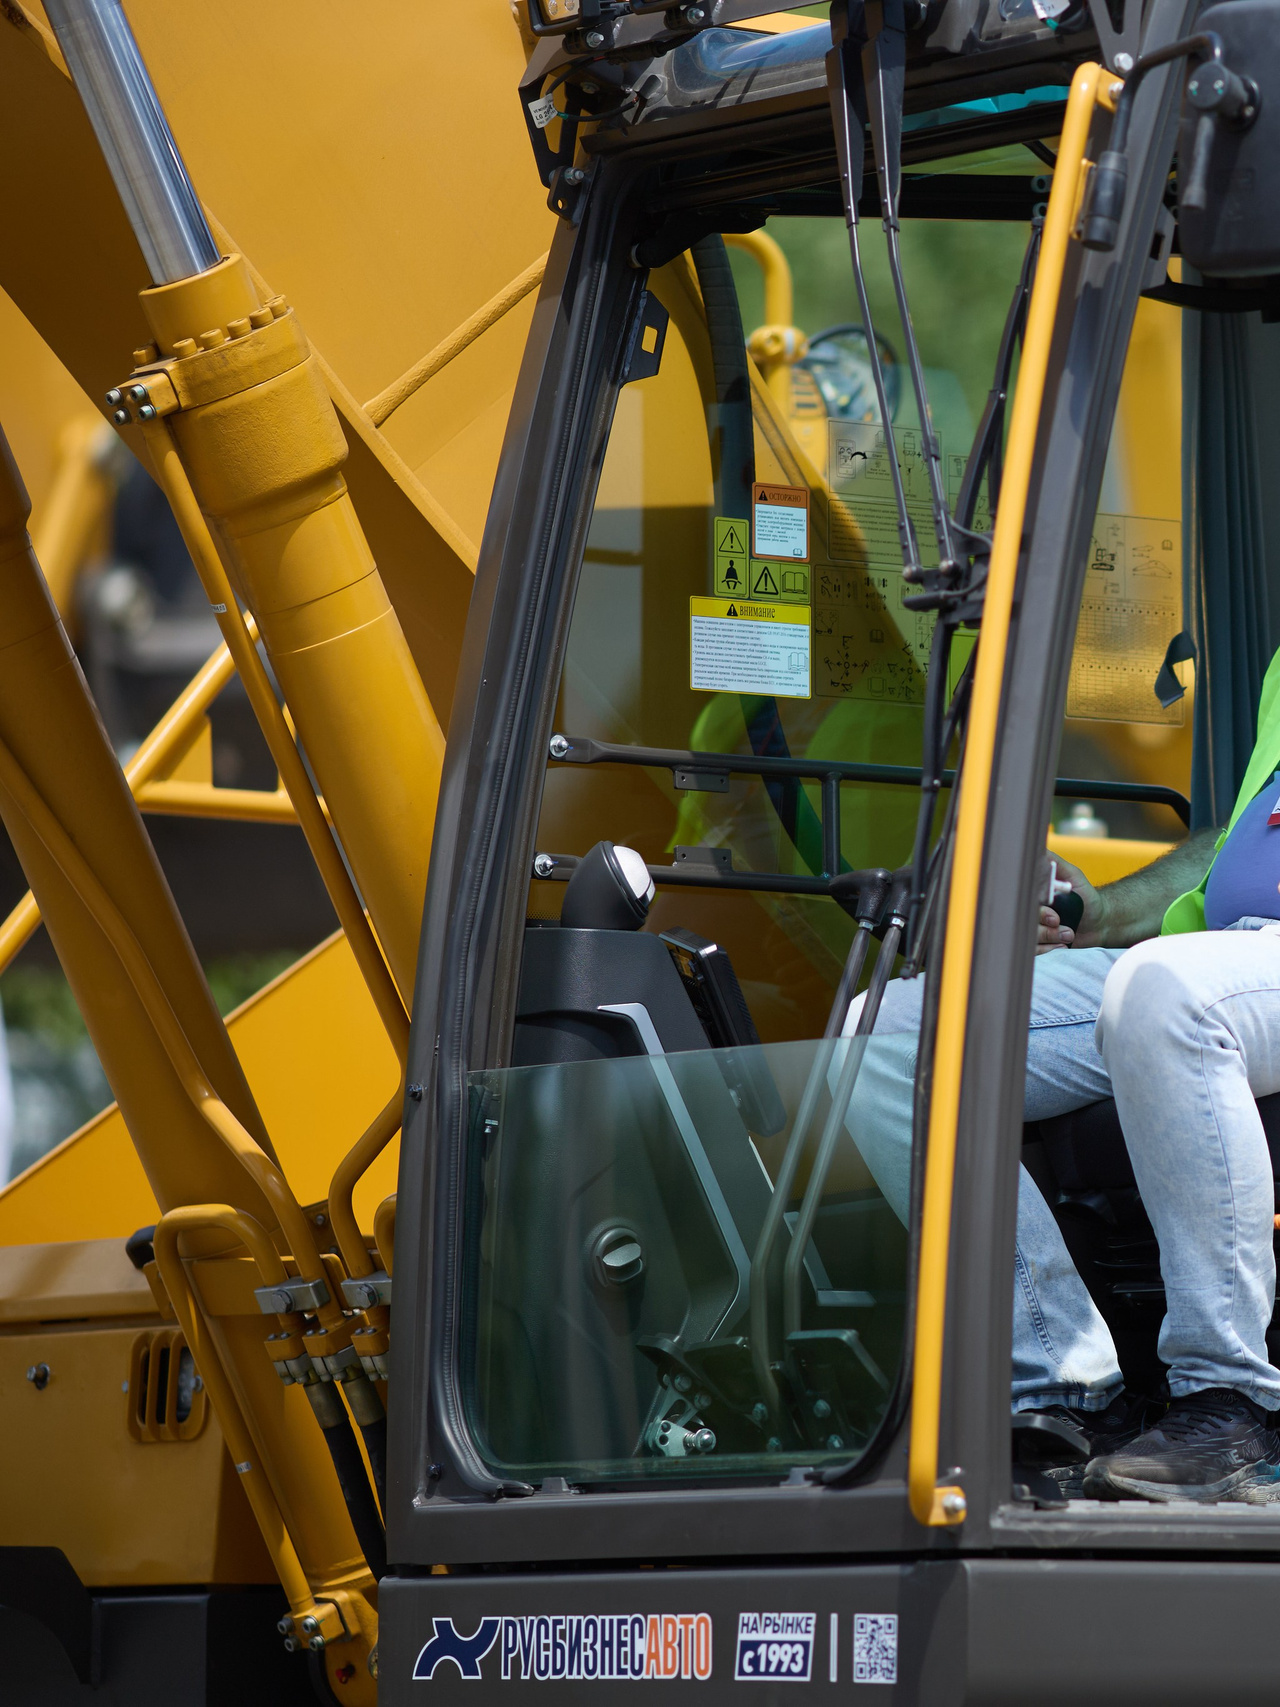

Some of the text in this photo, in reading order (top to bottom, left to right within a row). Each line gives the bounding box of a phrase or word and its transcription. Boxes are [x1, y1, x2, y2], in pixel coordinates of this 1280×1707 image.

[741, 1615, 813, 1634] НА РЫНКЕ
[502, 1614, 712, 1679] РУСБИЗНЕСАВТО
[757, 1643, 804, 1674] 1993
